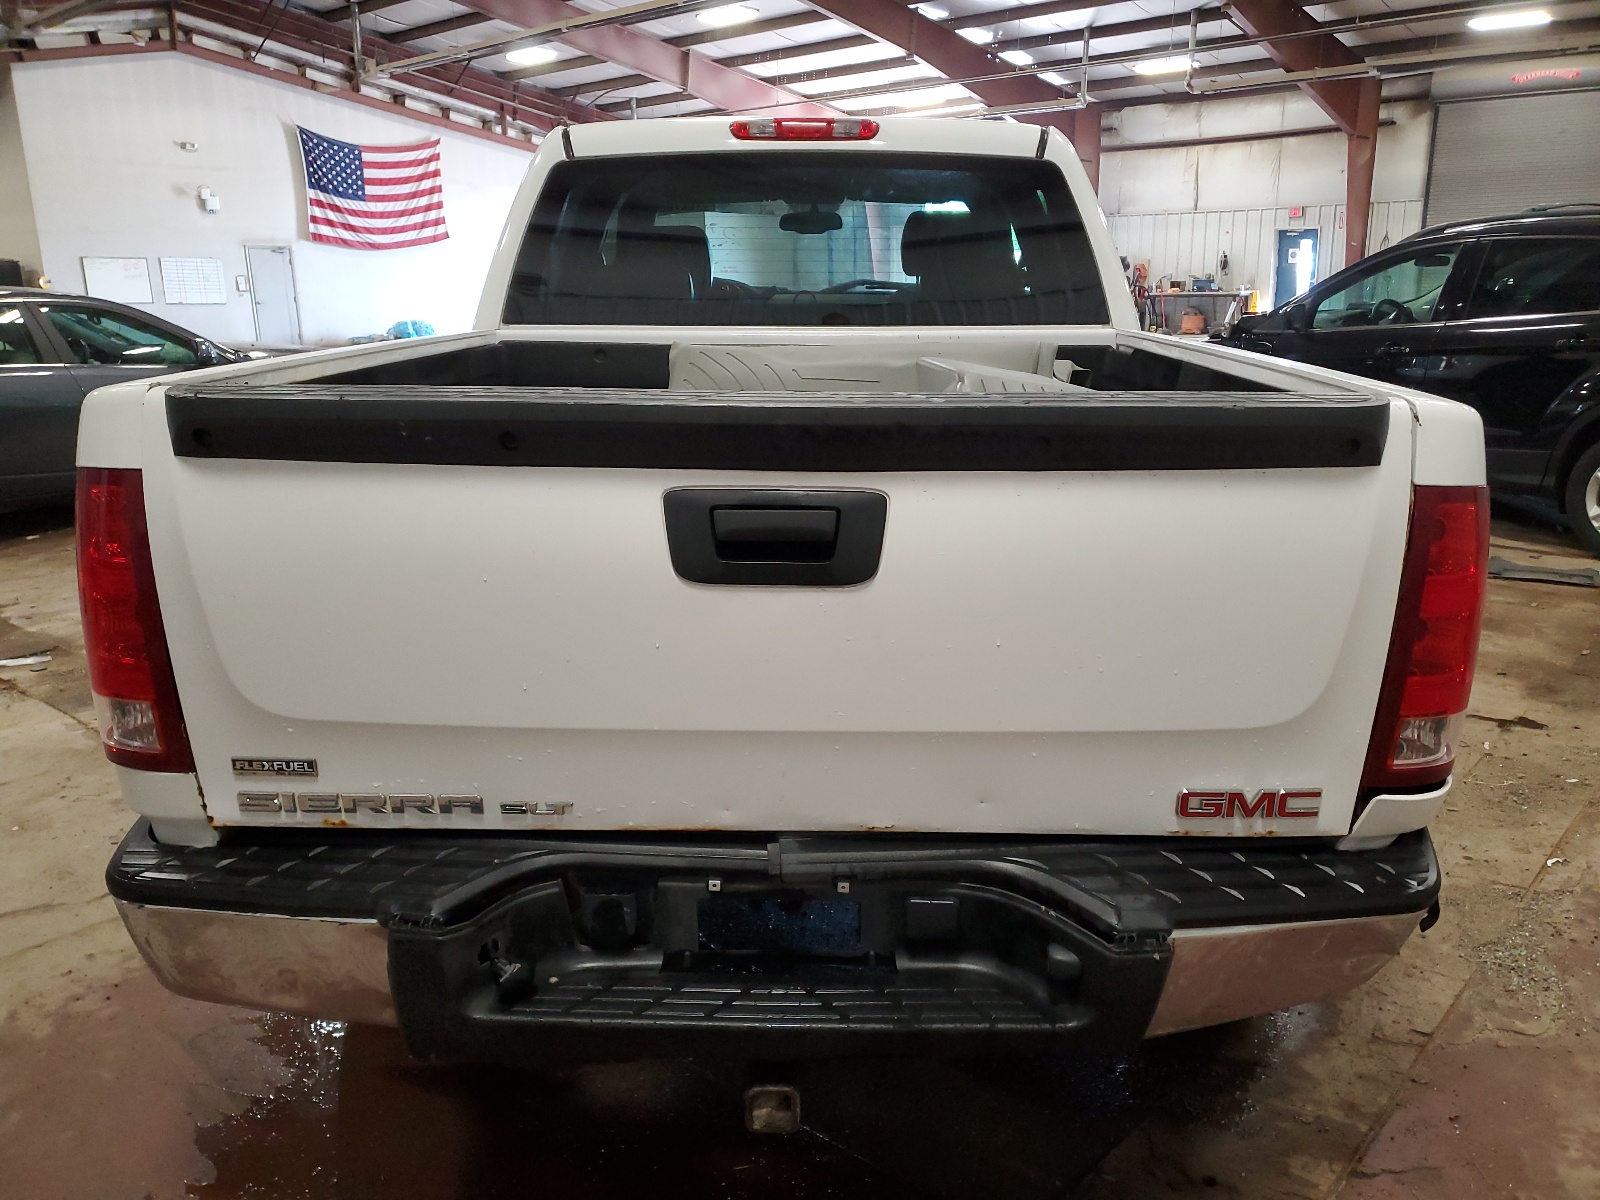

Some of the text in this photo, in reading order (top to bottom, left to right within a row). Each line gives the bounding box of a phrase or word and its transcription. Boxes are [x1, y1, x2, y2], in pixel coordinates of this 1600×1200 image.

[233, 760, 313, 772] FLEXFUEL
[237, 791, 574, 815] SIERRA SLT
[1176, 788, 1323, 819] GMC
